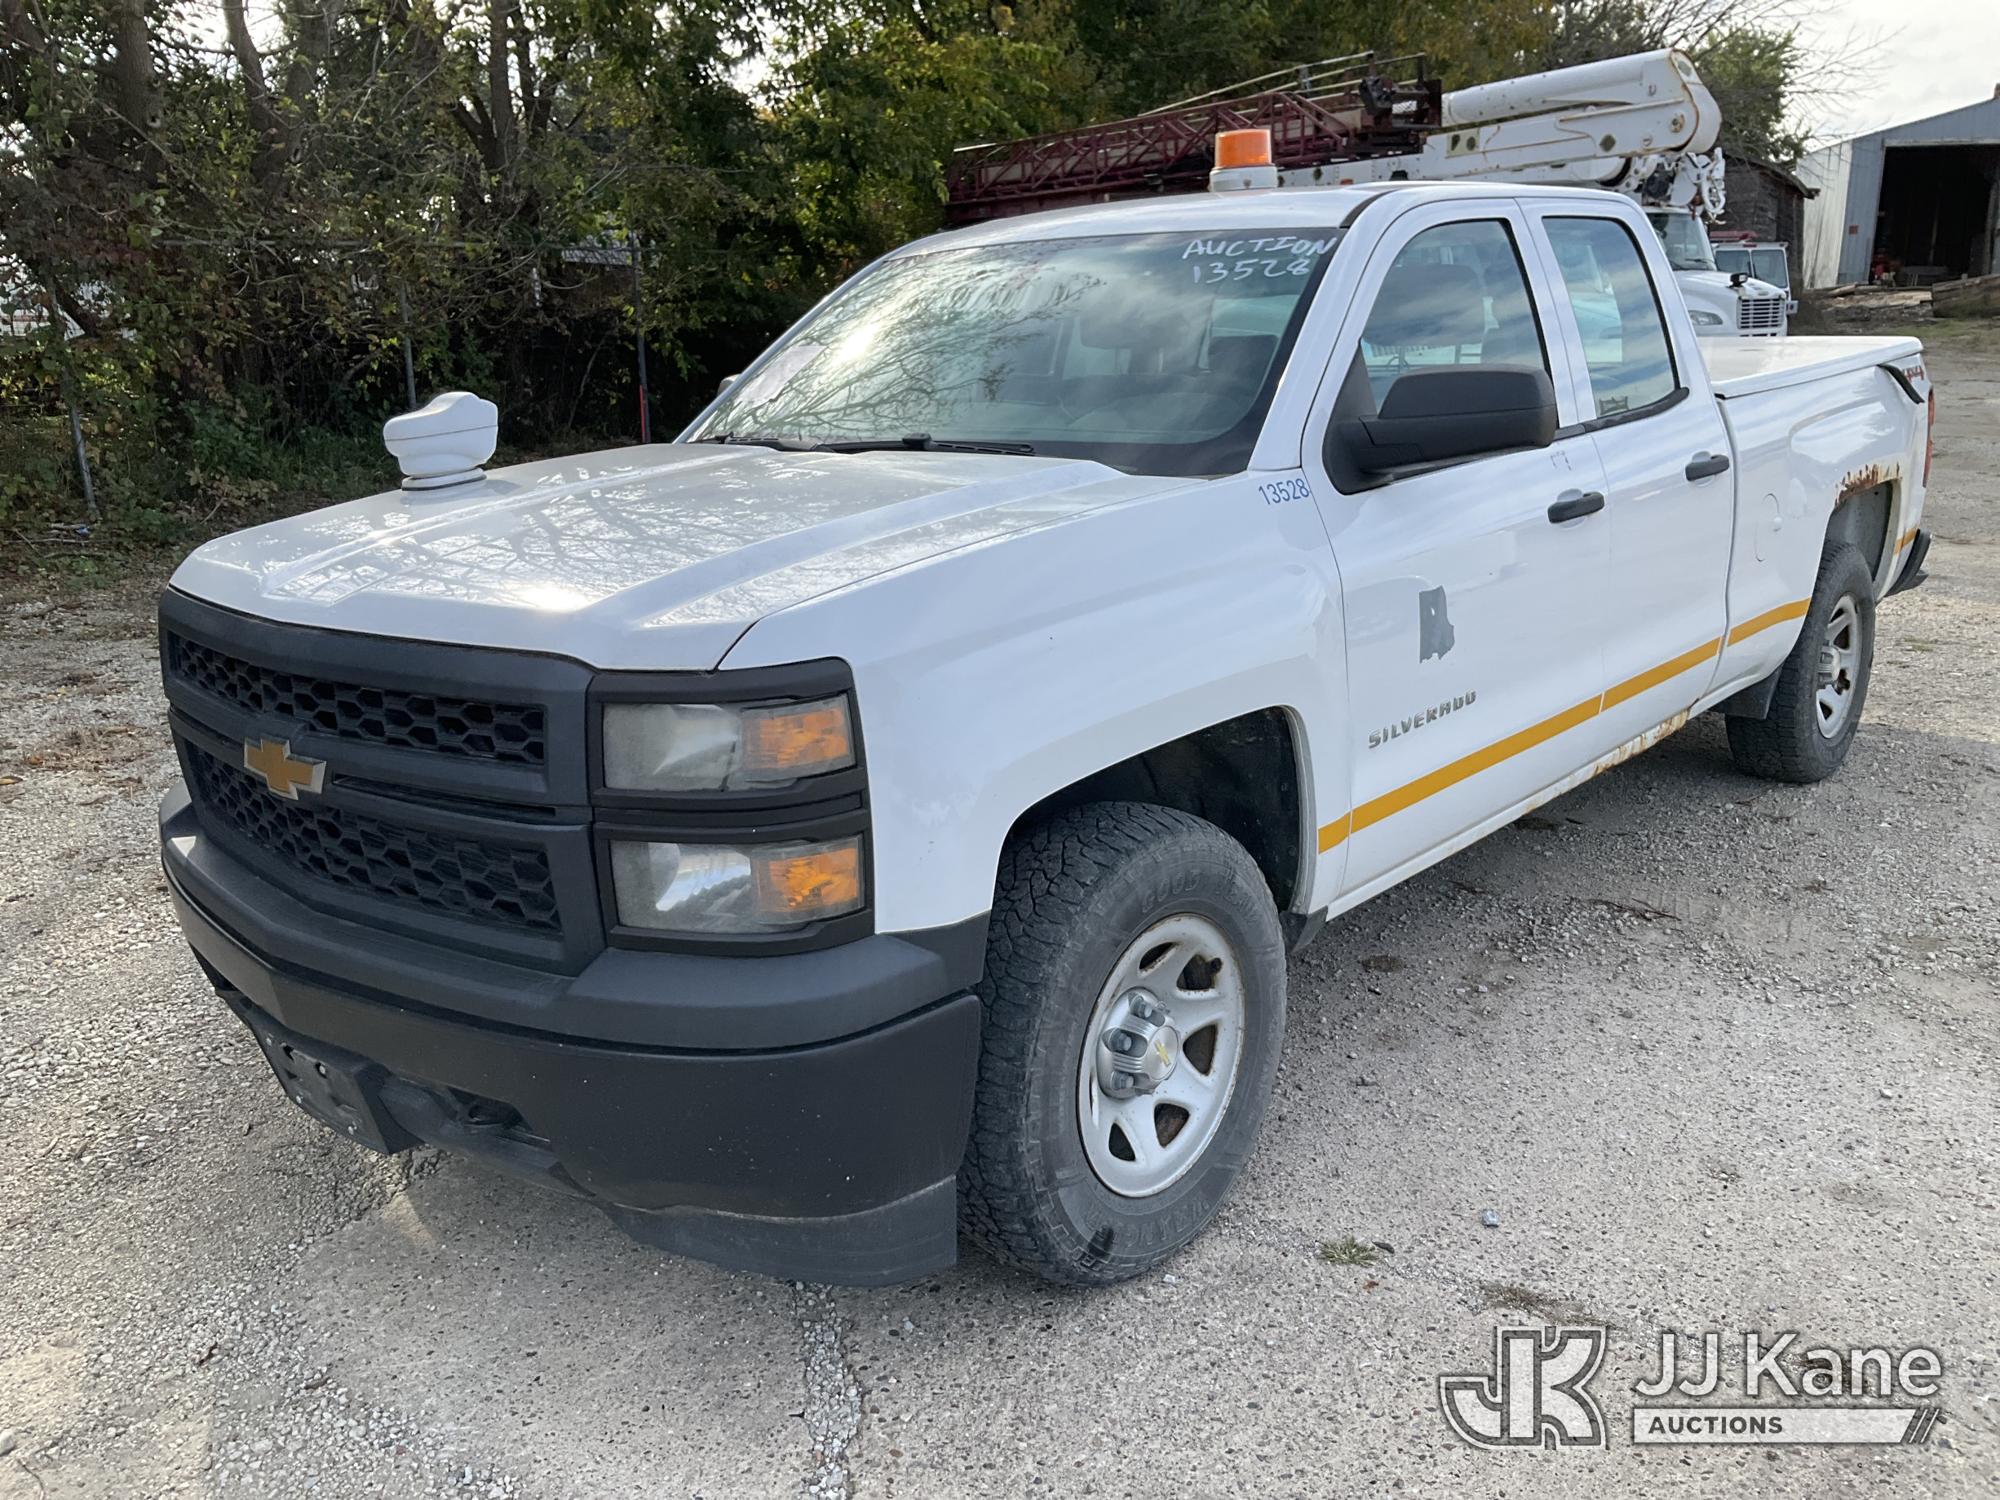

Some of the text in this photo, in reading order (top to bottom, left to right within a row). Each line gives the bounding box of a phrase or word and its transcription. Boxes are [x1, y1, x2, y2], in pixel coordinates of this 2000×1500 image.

[1181, 235, 1338, 260] AUCTION
[1192, 257, 1312, 284] 13528
[1258, 478, 1310, 505] 13528
[1368, 690, 1477, 749] SILVERADO
